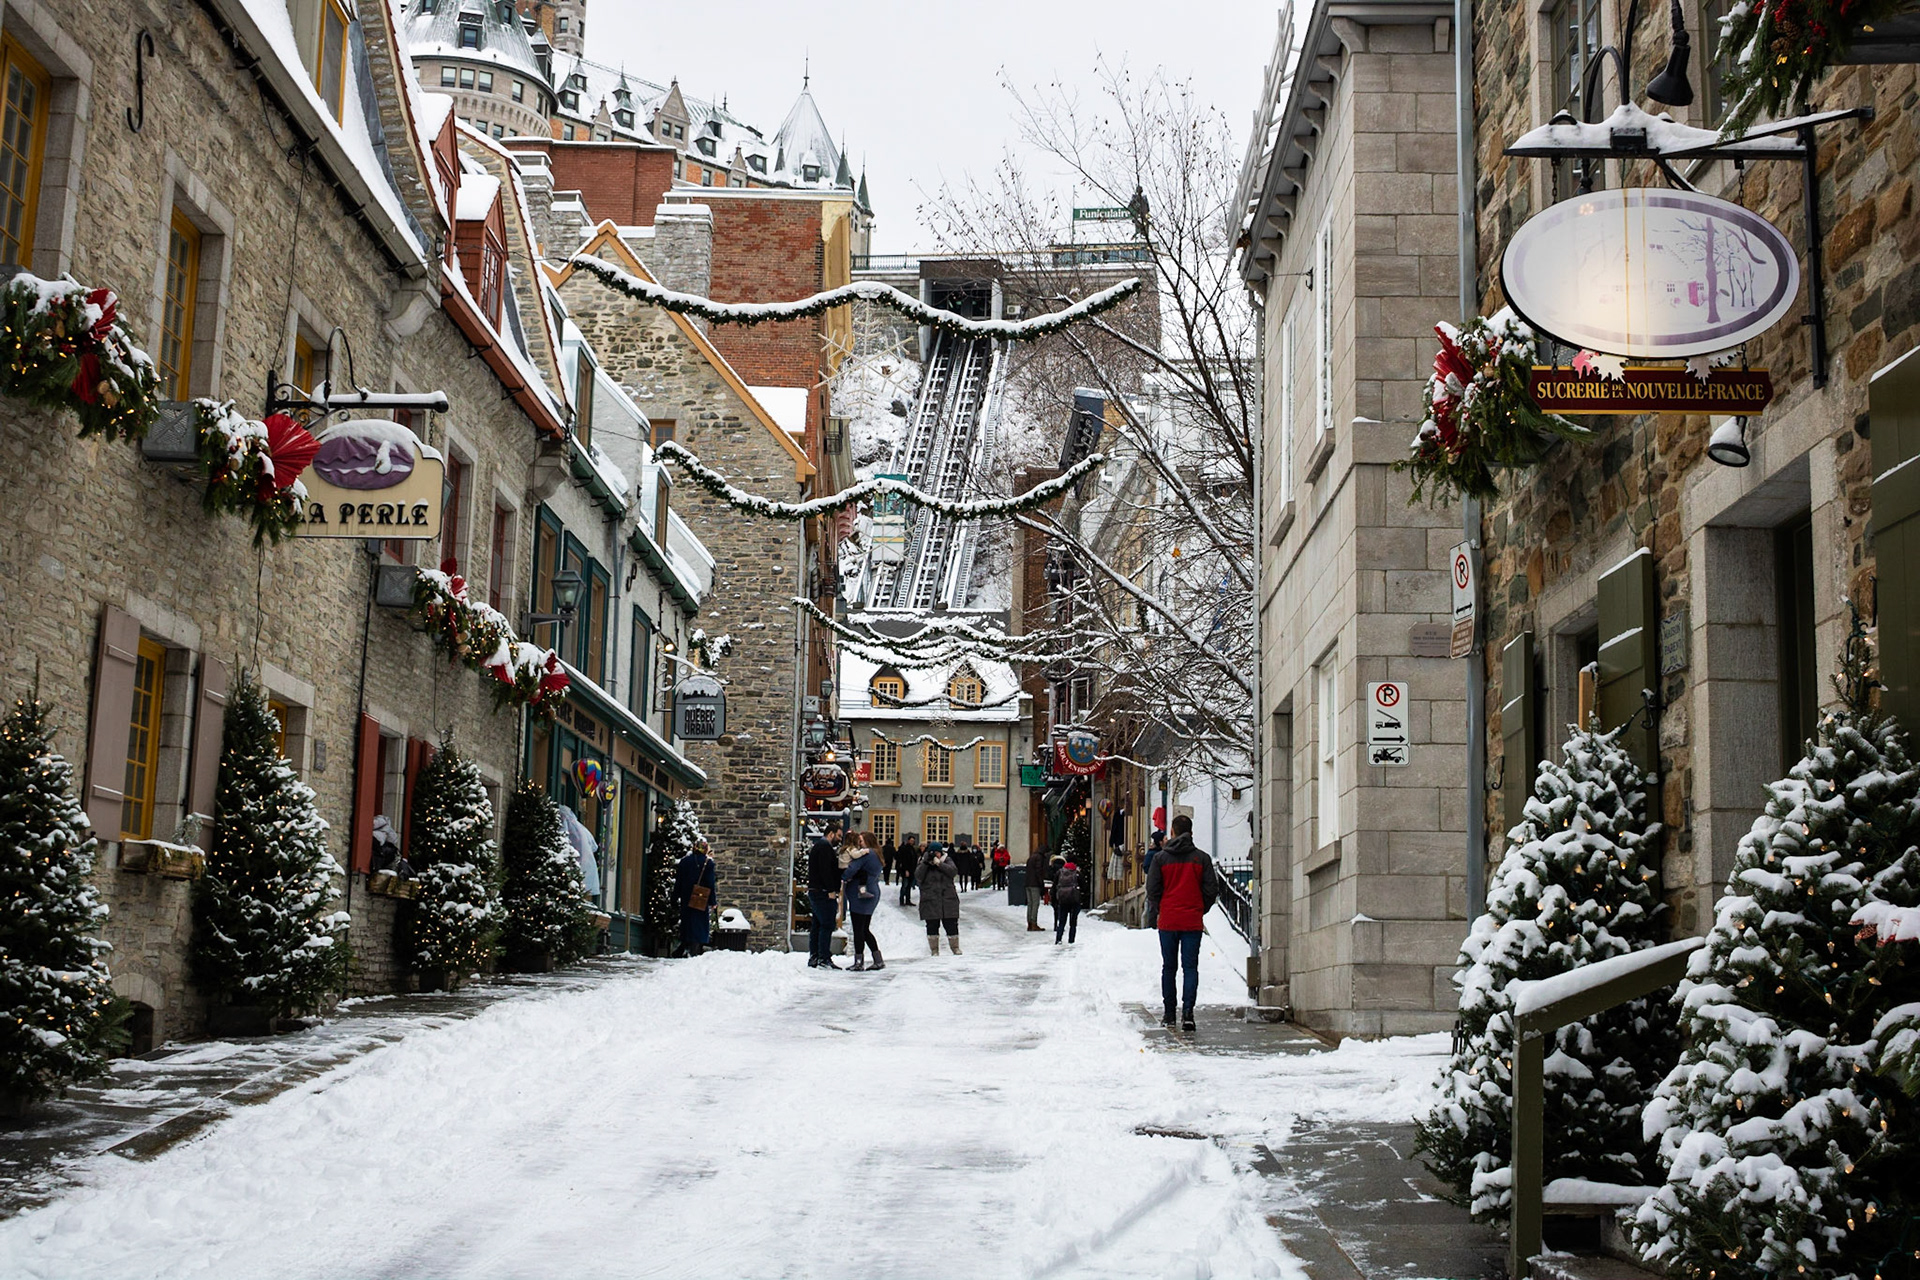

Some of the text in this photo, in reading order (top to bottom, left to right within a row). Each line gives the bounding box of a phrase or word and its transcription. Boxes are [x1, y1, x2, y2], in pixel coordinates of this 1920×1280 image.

[1079, 208, 1131, 218] Funiculaire
[1537, 381, 1610, 399] SUCRERIE
[1627, 382, 1765, 400] NOUVELLE-FRANCE
[300, 502, 429, 526] A PERLE
[685, 707, 716, 722] QUÉBEC
[684, 722, 715, 735] URBAIN
[1058, 746, 1090, 773] SOUVENIRS
[892, 793, 984, 805] FUNICULAIRE
